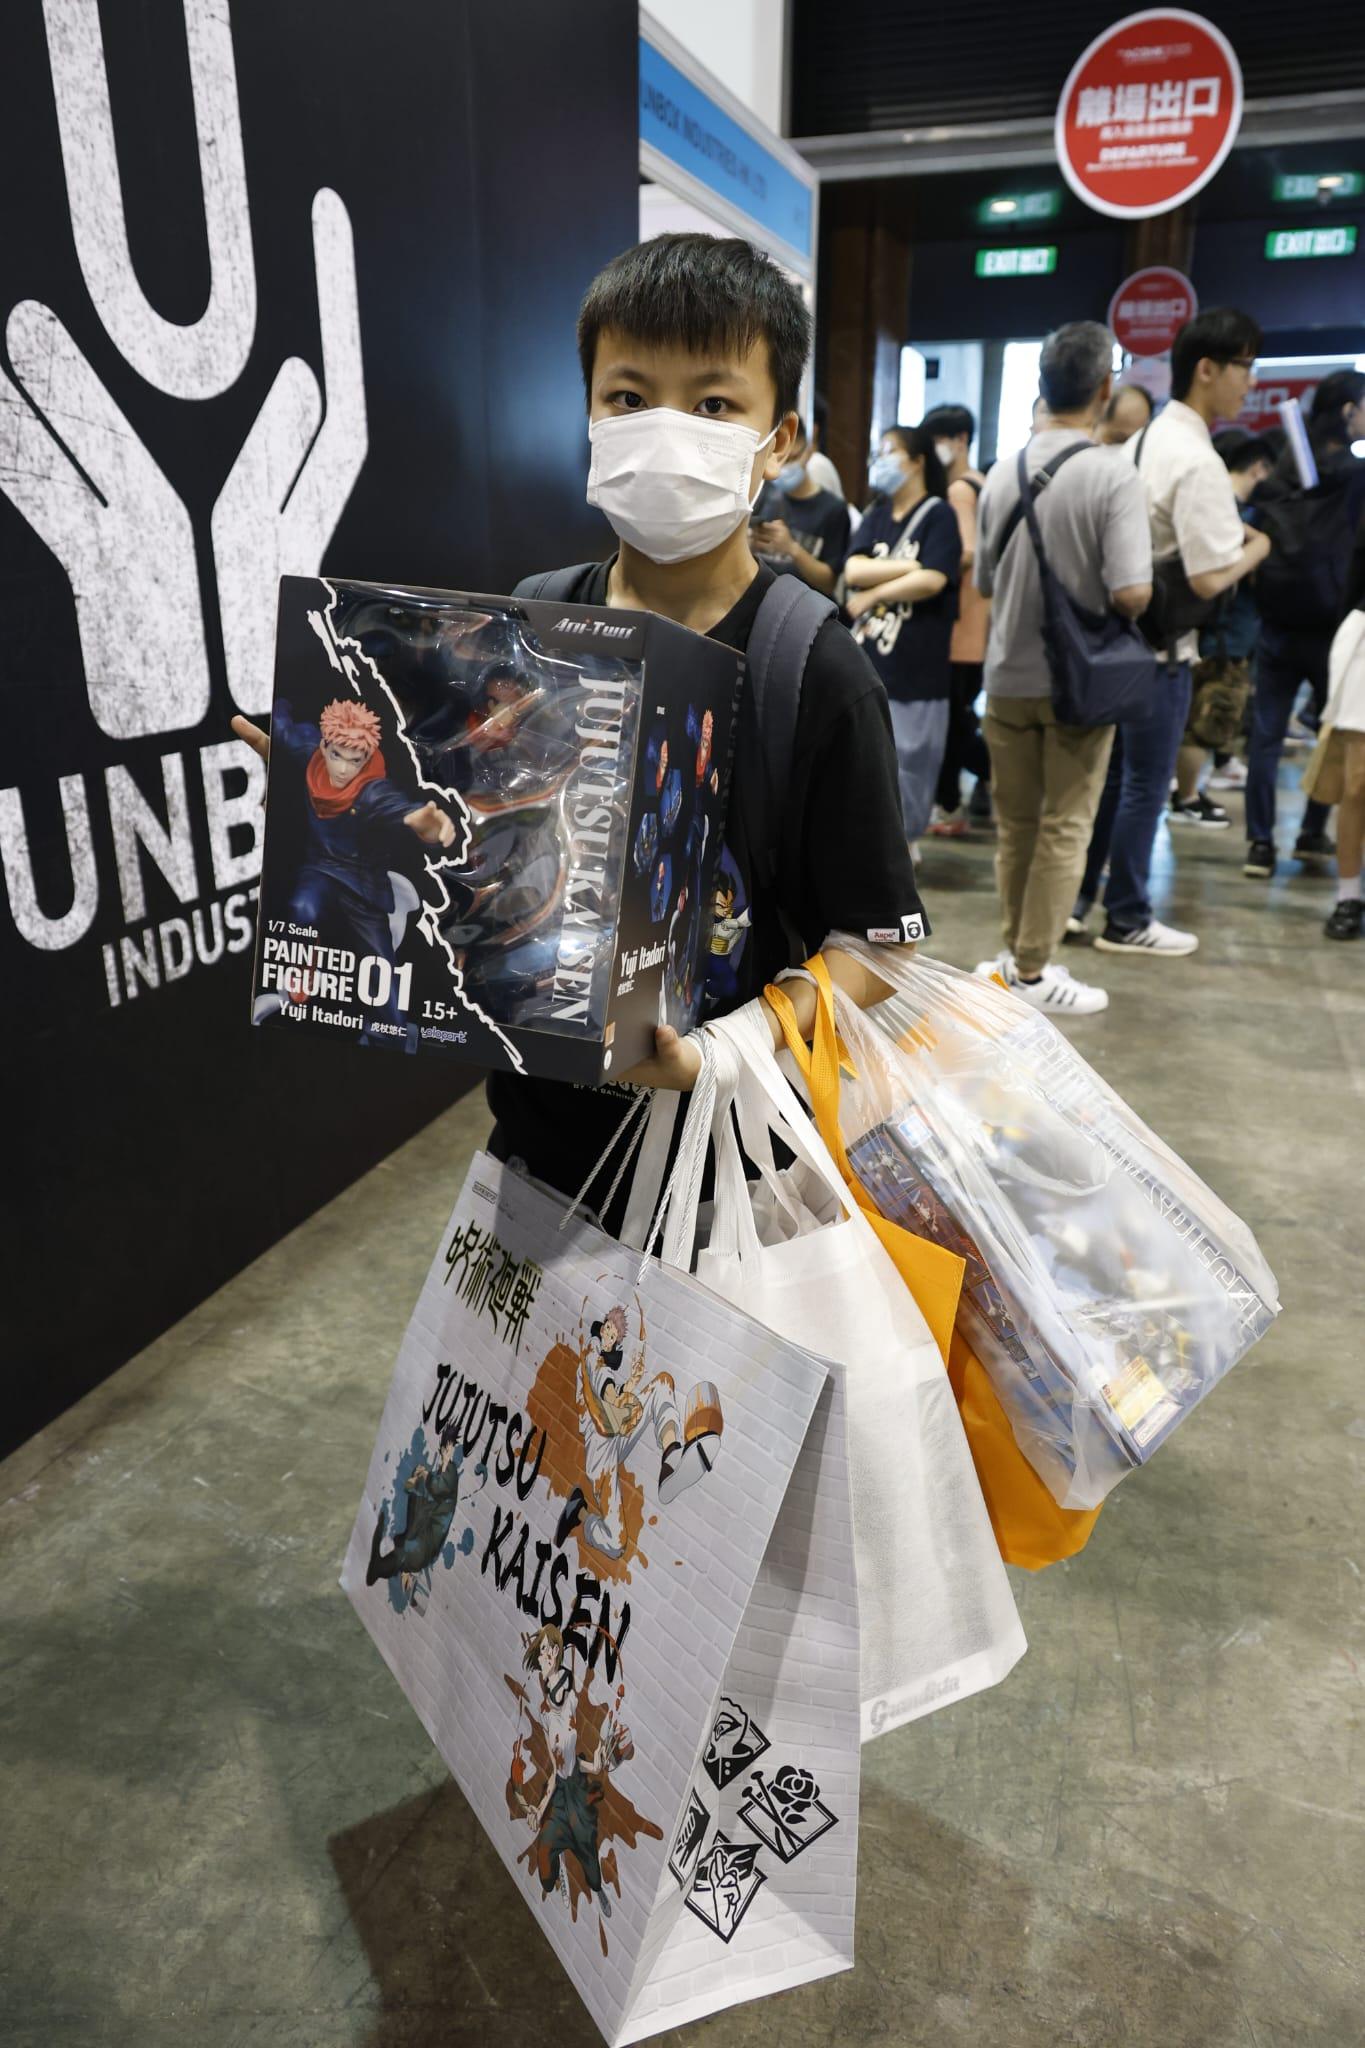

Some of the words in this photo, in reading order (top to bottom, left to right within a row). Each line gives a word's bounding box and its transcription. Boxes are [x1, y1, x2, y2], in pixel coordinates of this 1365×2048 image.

[984, 249, 1018, 276] EXIT
[1274, 230, 1313, 258] EXIT
[573, 673, 627, 861] JUJUTSU
[102, 884, 260, 1008] INDUS
[267, 919, 285, 933] 1/7
[288, 923, 319, 938] Scale
[551, 866, 606, 1027] KAISEN
[263, 937, 356, 974] PAINTED
[620, 949, 639, 979] Yuji
[638, 940, 666, 971] Itadori
[262, 962, 354, 1003] FIGURE
[357, 955, 413, 1011] 01
[279, 1000, 307, 1022] Yuji
[312, 1005, 364, 1030] Itadori
[422, 1000, 458, 1021] 15+
[423, 1362, 547, 1501] JUJUTSU
[481, 1503, 631, 1686] KAISEN
